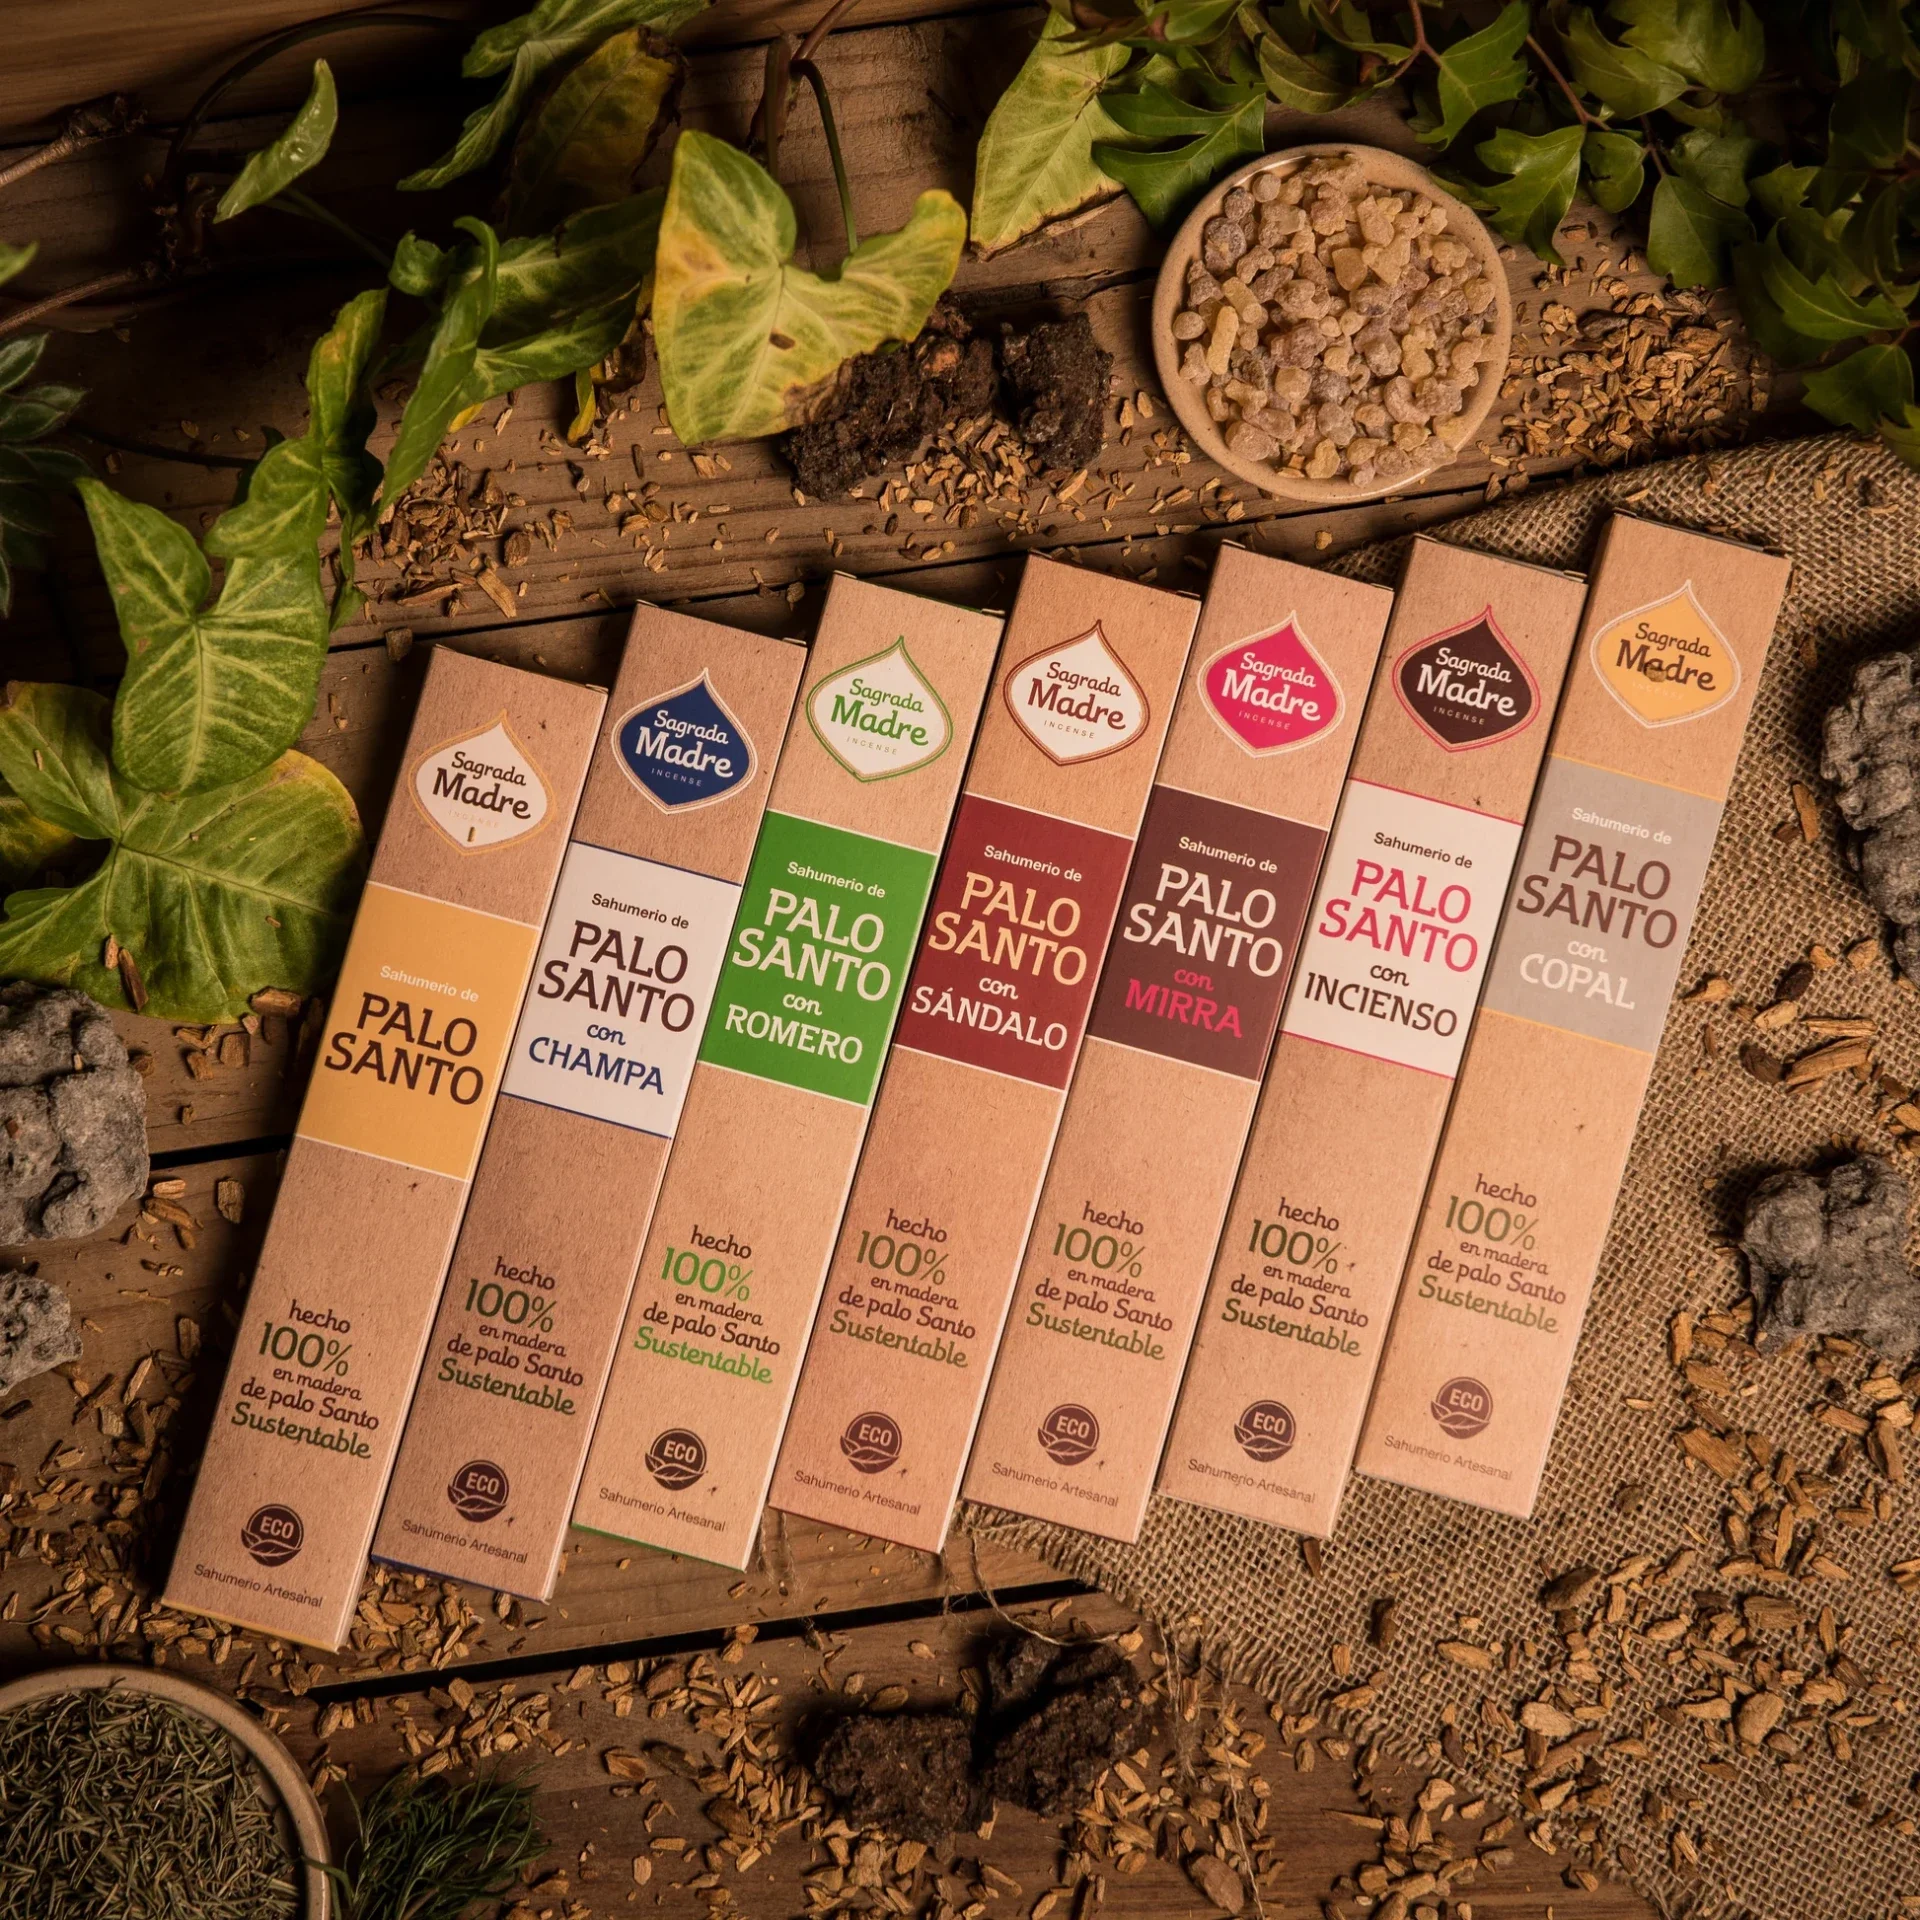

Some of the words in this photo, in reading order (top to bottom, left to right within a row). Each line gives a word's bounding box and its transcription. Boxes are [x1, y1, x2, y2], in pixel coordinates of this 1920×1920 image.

[1635, 622, 1711, 657] Sagrada
[1046, 662, 1121, 697] Sagrada
[1240, 652, 1316, 687] Sagrada
[1436, 648, 1511, 683] Sagrada
[849, 678, 924, 713] Sagrada
[1027, 678, 1126, 730] Madre
[1221, 668, 1321, 721] Madre
[1417, 664, 1516, 716] Madre
[654, 710, 728, 744] Sagrada
[830, 694, 929, 746] Madre
[1044, 721, 1095, 739] INCENSE
[1238, 711, 1289, 730] INCENSE
[1434, 707, 1485, 725] INCENSE
[635, 726, 733, 777] Madre
[847, 737, 898, 755] INCENSE
[451, 751, 526, 786] Sagrada
[652, 768, 702, 786] INCENSE
[432, 767, 531, 819] Madre
[1572, 808, 1649, 838] Sahumerio
[1654, 830, 1672, 843] de
[984, 846, 1060, 875] Sahumerio
[1064, 868, 1082, 880] de
[1180, 838, 1255, 867] Sahumerio
[1260, 860, 1277, 872] de
[1375, 832, 1451, 862] Sahumerio
[1455, 854, 1473, 868] de
[1550, 834, 1671, 899] PALO
[787, 862, 864, 892] Sahumerio
[868, 884, 886, 897] de
[1156, 863, 1277, 928] PALO
[1351, 859, 1472, 924] PALO
[592, 894, 667, 923] Sahumerio
[672, 916, 689, 928] de
[764, 888, 885, 953] PALO
[960, 872, 1081, 937] PALO
[1518, 875, 1677, 948] SANTO
[569, 920, 688, 984] PALO
[929, 912, 1087, 985] SANTO
[1125, 903, 1283, 976] SANTO
[1320, 899, 1478, 972] SANTO
[1567, 940, 1608, 962] con
[381, 966, 457, 995] Sahumerio
[461, 988, 479, 1000] de
[733, 928, 891, 1001] SANTO
[1175, 969, 1214, 990] con
[1370, 965, 1409, 986] con
[1520, 954, 1635, 1010] COPAL
[538, 960, 694, 1032] SANTO
[783, 994, 822, 1016] con
[979, 977, 1019, 999] con
[1125, 978, 1243, 1039] MIRRA
[1304, 971, 1458, 1038] INCIENSO
[357, 992, 478, 1057] PALO
[587, 1024, 626, 1046] con
[725, 1004, 862, 1065] ROMERO
[910, 986, 1068, 1051] SÁNDALO
[326, 1032, 484, 1105] SANTO
[528, 1036, 664, 1095] CHAMPA
[1475, 1172, 1537, 1207] hecho
[886, 1208, 946, 1243] hecho
[1083, 1200, 1143, 1235] hecho
[1279, 1196, 1339, 1231] hecho
[1445, 1195, 1539, 1251] 100%
[691, 1224, 751, 1259] hecho
[856, 1230, 948, 1286] 100%
[1053, 1222, 1145, 1278] 100%
[1249, 1218, 1341, 1274] 100%
[1460, 1242, 1480, 1256] en
[1483, 1248, 1549, 1275] madera
[494, 1255, 554, 1290] hecho
[661, 1246, 753, 1302] 100%
[870, 1277, 890, 1291] en
[894, 1283, 958, 1310] madera
[1068, 1269, 1088, 1283] en
[1090, 1275, 1155, 1302] madera
[1264, 1265, 1284, 1279] en
[1286, 1271, 1351, 1298] madera
[1427, 1250, 1454, 1274] de
[1456, 1264, 1501, 1286] palo
[1506, 1271, 1565, 1305] Santo
[289, 1299, 349, 1334] hecho
[464, 1278, 556, 1333] 100%
[676, 1293, 696, 1307] en
[698, 1299, 763, 1326] madera
[838, 1286, 864, 1308] de
[866, 1298, 911, 1321] palo
[916, 1306, 974, 1339] Santo
[1035, 1278, 1061, 1300] de
[1063, 1290, 1108, 1313] palo
[1113, 1298, 1172, 1331] Santo
[1231, 1274, 1257, 1296] de
[1259, 1286, 1304, 1309] palo
[1309, 1294, 1368, 1327] Santo
[1418, 1275, 1558, 1333] Sustentable
[478, 1324, 498, 1338] en
[502, 1330, 566, 1356] madera
[643, 1302, 669, 1324] de
[671, 1314, 716, 1337] palo
[721, 1322, 780, 1355] Santo
[828, 1310, 968, 1367] Sustentable
[1026, 1302, 1164, 1359] Sustentable
[1222, 1298, 1360, 1355] Sustentable
[259, 1322, 351, 1377] 100%
[446, 1332, 472, 1356] de
[474, 1346, 519, 1368] palo
[524, 1353, 582, 1386] Santo
[634, 1326, 772, 1383] Sustentable
[241, 1376, 267, 1400] de
[269, 1390, 314, 1412] palo
[319, 1397, 378, 1430] Santo
[274, 1368, 294, 1382] en
[296, 1374, 361, 1400] madera
[436, 1357, 576, 1414] Sustentable
[1450, 1389, 1483, 1412] ECO
[232, 1401, 370, 1458] Sustentable
[858, 1423, 892, 1446] ECO
[1056, 1415, 1090, 1438] ECO
[1252, 1412, 1286, 1435] ECO
[664, 1440, 697, 1463] ECO
[1384, 1436, 1451, 1464] Sahumerio
[1454, 1456, 1513, 1480] Artesanal
[466, 1472, 499, 1494] ECO
[794, 1470, 860, 1498] Sahumerio
[862, 1490, 920, 1514] Artesanal
[992, 1462, 1058, 1490] Sahumerio
[1060, 1482, 1118, 1506] Artesanal
[1187, 1459, 1254, 1487] Sahumerio
[1257, 1479, 1316, 1503] Artesanal
[260, 1515, 294, 1539] ECO
[599, 1488, 664, 1515] Sahumerio
[668, 1508, 726, 1532] Artesanal
[401, 1520, 466, 1547] Sahumerio
[470, 1540, 528, 1564] Artesanal
[194, 1564, 260, 1591] Sahumerio
[263, 1584, 321, 1608] Artesanal
